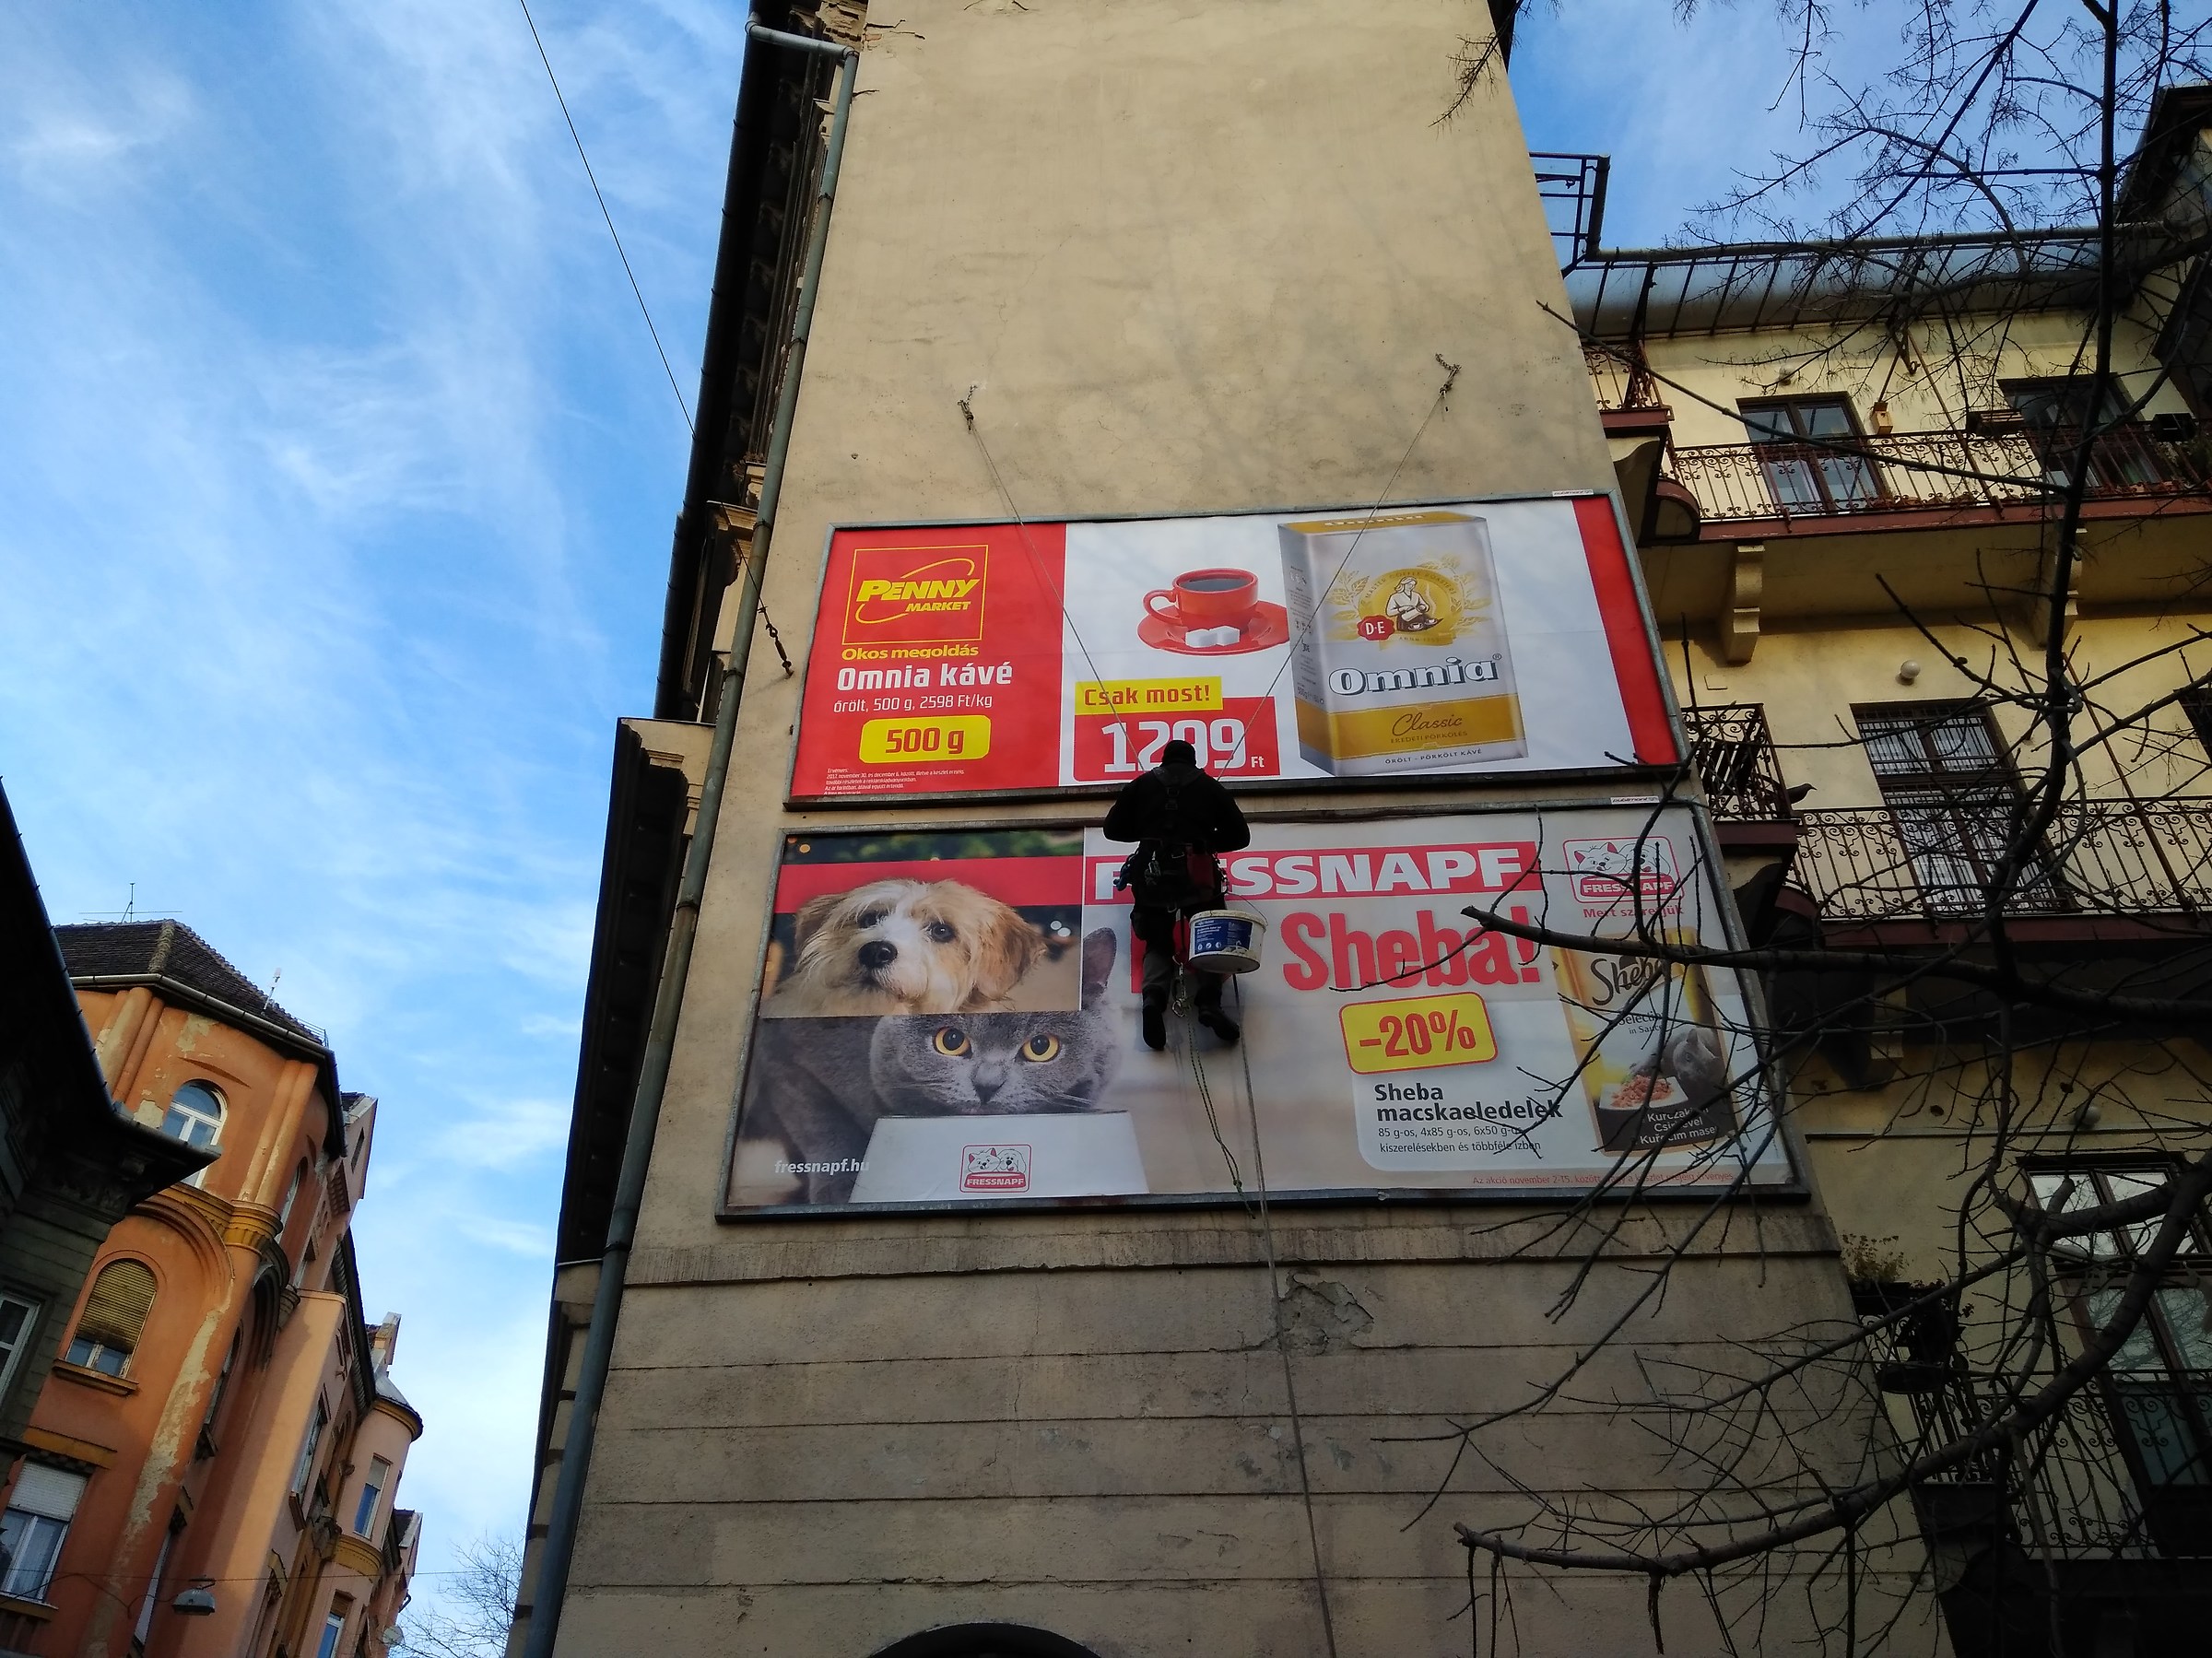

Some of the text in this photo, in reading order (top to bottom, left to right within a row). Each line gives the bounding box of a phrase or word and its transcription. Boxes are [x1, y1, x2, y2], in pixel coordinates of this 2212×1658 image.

[856, 579, 980, 602] PENNY
[905, 601, 971, 612] MARKET
[841, 644, 979, 662] Okos megoldás
[837, 662, 1013, 691] Omnia kávé
[1329, 657, 1500, 696] Omnia
[873, 698, 900, 711] 500
[904, 698, 915, 712] g,
[920, 695, 955, 709] 2598
[958, 693, 994, 709] Ft/kg
[1085, 685, 1210, 706] Csak most!
[1392, 711, 1464, 737] Classic
[885, 727, 965, 755] 500 g
[1101, 718, 1265, 773] 1299 Ft
[1460, 747, 1483, 757] KÁVÉ
[1096, 849, 1522, 900] FSSNAPF
[1583, 881, 1674, 894] FRESSAPF
[1620, 905, 1684, 918] szrejük
[1280, 906, 1540, 991] Sheba!
[1591, 956, 1665, 1006] Sheb
[1374, 1083, 1443, 1101] Sheba
[1377, 1099, 1563, 1122] macskaeledelek
[1378, 1127, 1391, 1136] 85
[1394, 1129, 1418, 1139] g-os,
[1420, 1126, 1443, 1136] 4x85
[1447, 1128, 1471, 1138] g-os,
[1474, 1126, 1498, 1135] 6x50
[1653, 1116, 1703, 1133] Csirvel
[1380, 1142, 1455, 1153] kiszerelésekben
[1458, 1142, 1469, 1151] és
[1472, 1141, 1512, 1151] többféle
[774, 1158, 869, 1176] fressnapf.hu
[967, 1178, 1025, 1186] FRESSNAPF
[1486, 1176, 1508, 1184] akció
[1510, 1175, 1549, 1184] november
